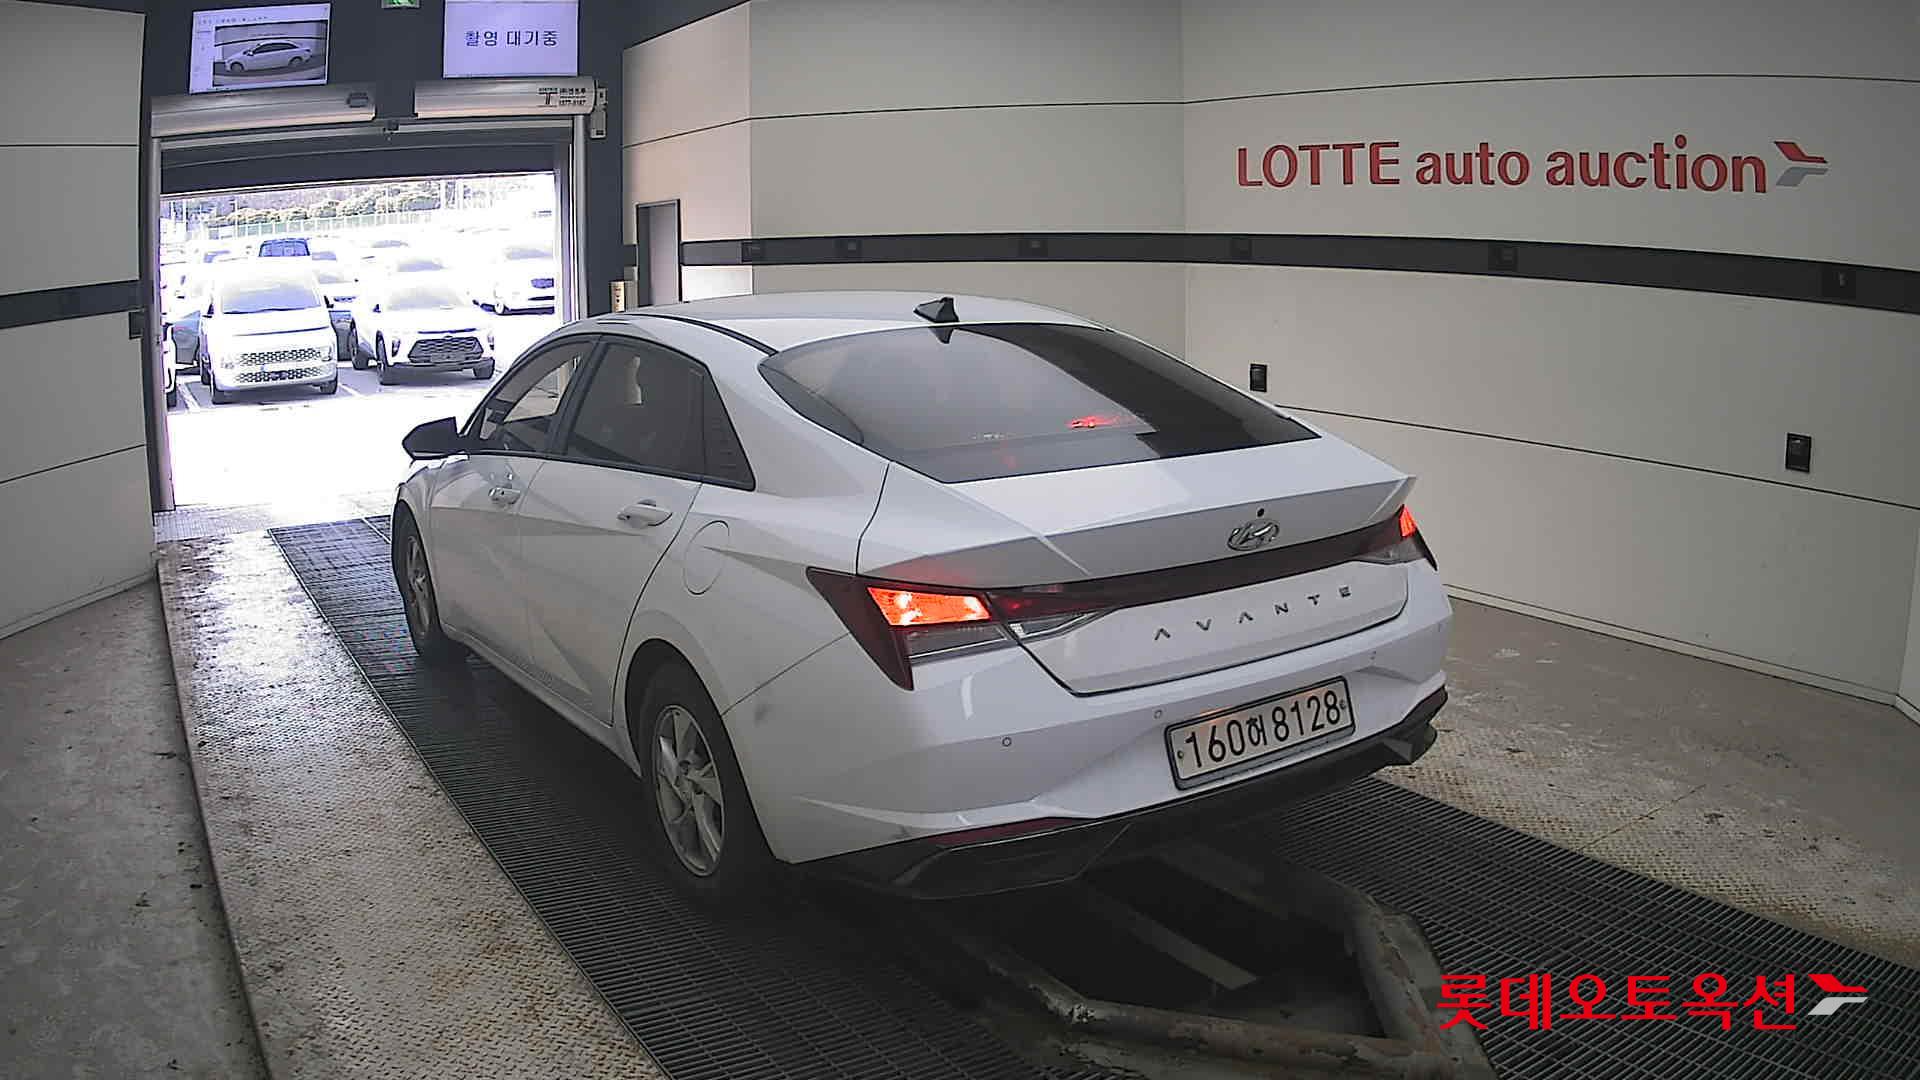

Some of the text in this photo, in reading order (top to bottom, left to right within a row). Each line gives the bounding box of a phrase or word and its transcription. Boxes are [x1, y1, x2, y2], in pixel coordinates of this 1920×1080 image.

[465, 30, 557, 47] 촬영 대기중
[1237, 134, 1766, 194] LOTTE auto auction
[1154, 585, 1352, 641] AVANTE
